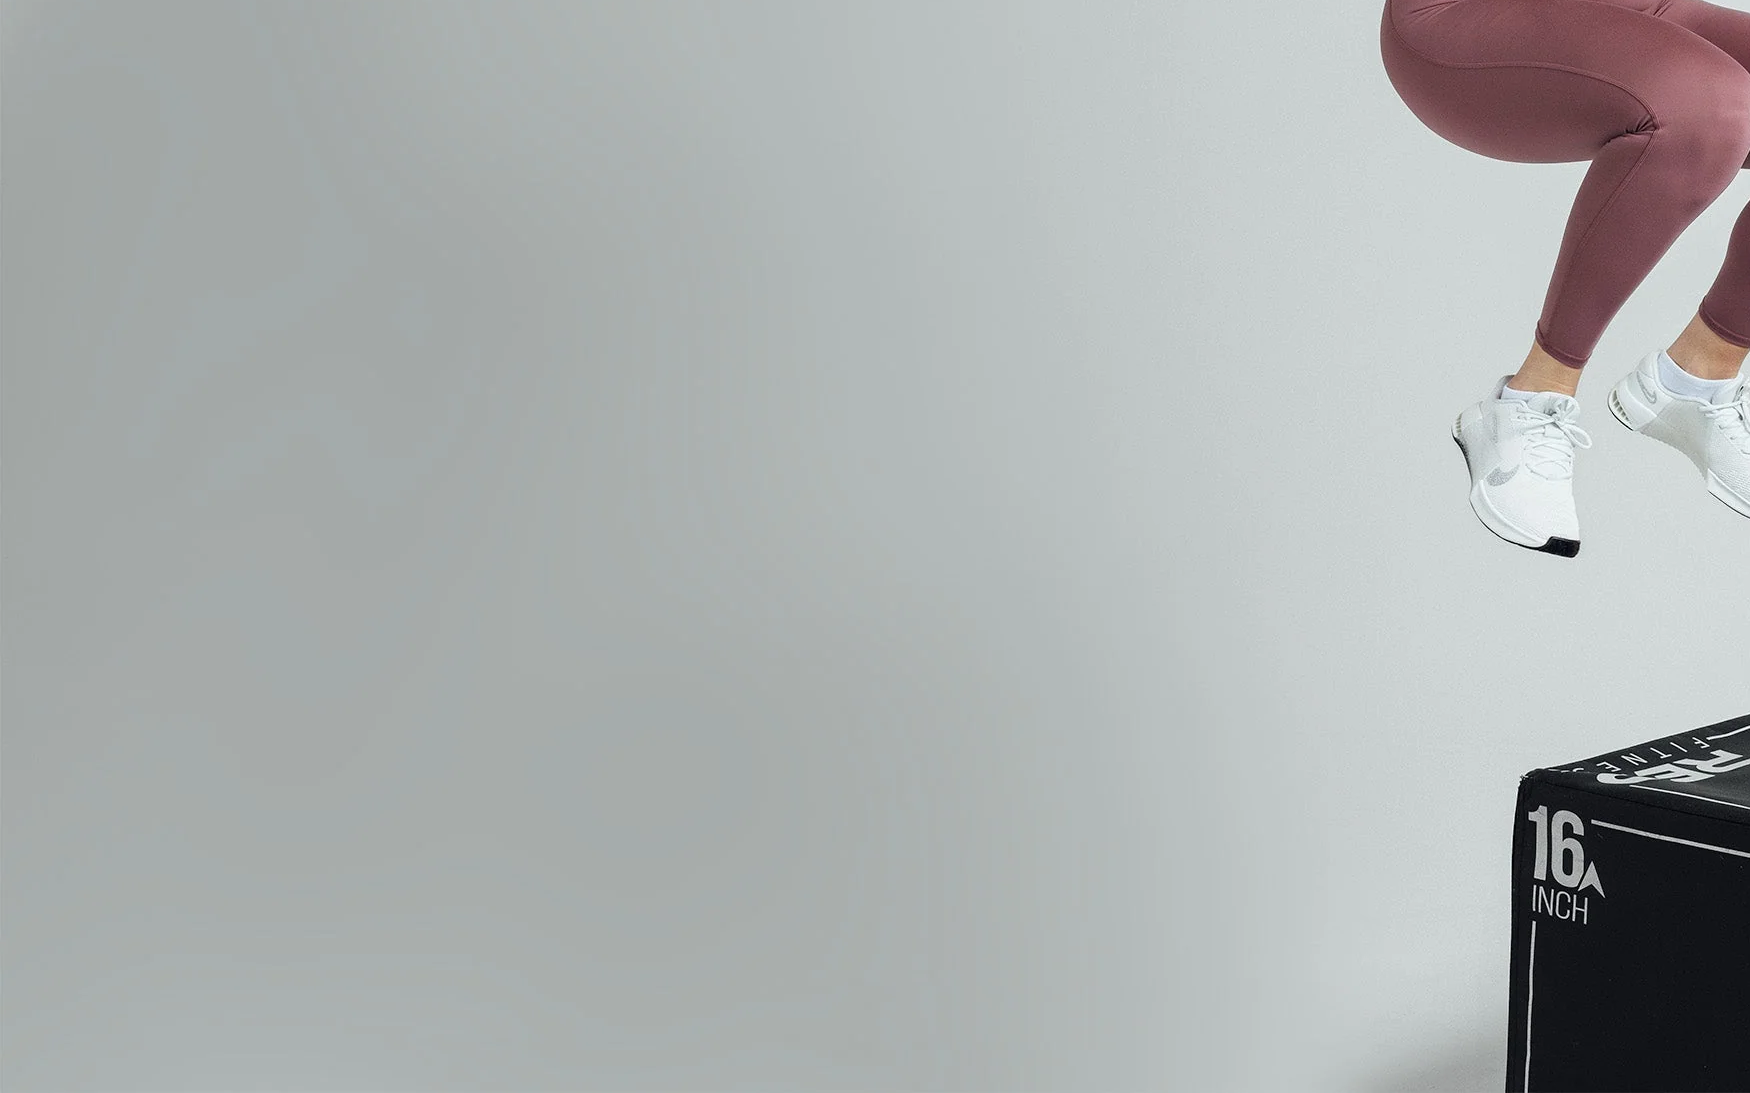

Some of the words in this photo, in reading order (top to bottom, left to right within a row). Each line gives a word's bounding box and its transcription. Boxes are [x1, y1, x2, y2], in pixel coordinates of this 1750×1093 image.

[1548, 737, 1710, 773] FITNE
[1528, 805, 1585, 888] 16
[1532, 884, 1589, 925] INCH
